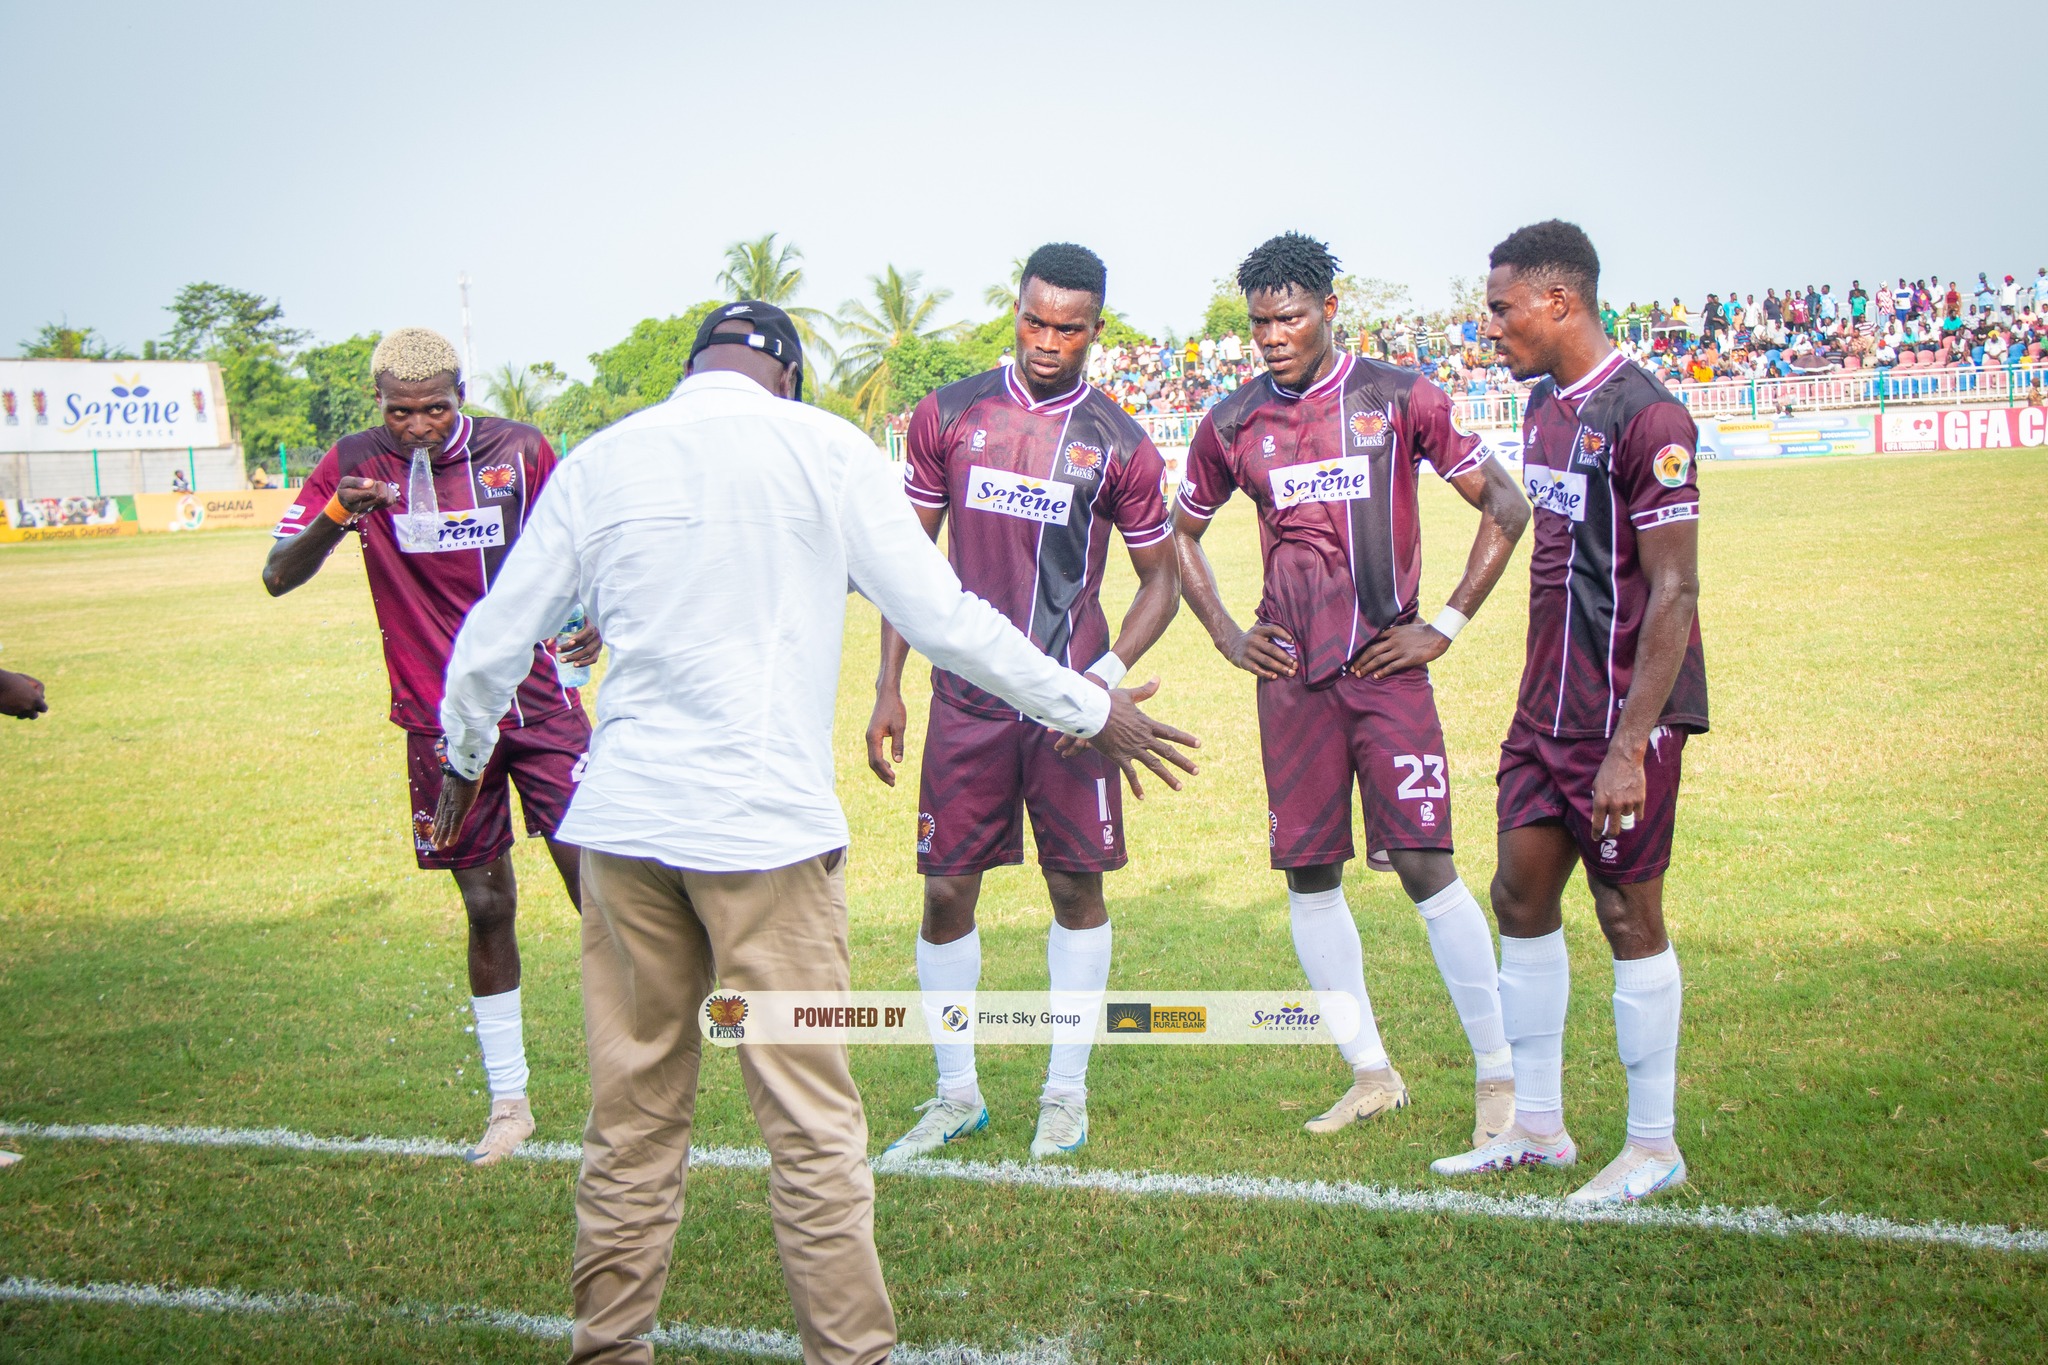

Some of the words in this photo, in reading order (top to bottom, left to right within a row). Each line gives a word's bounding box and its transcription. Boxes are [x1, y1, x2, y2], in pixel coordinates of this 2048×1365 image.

[63, 393, 180, 426] Serene
[87, 429, 174, 438] Insurance
[1943, 409, 2012, 451] GFA
[2018, 406, 2048, 447] C
[1283, 474, 1365, 498] Serene
[207, 500, 254, 512] GHANA
[977, 481, 1067, 514] Serene
[992, 502, 1057, 520] Insurance
[438, 523, 500, 542] rene
[439, 538, 494, 549] surance
[1394, 754, 1447, 800] 23
